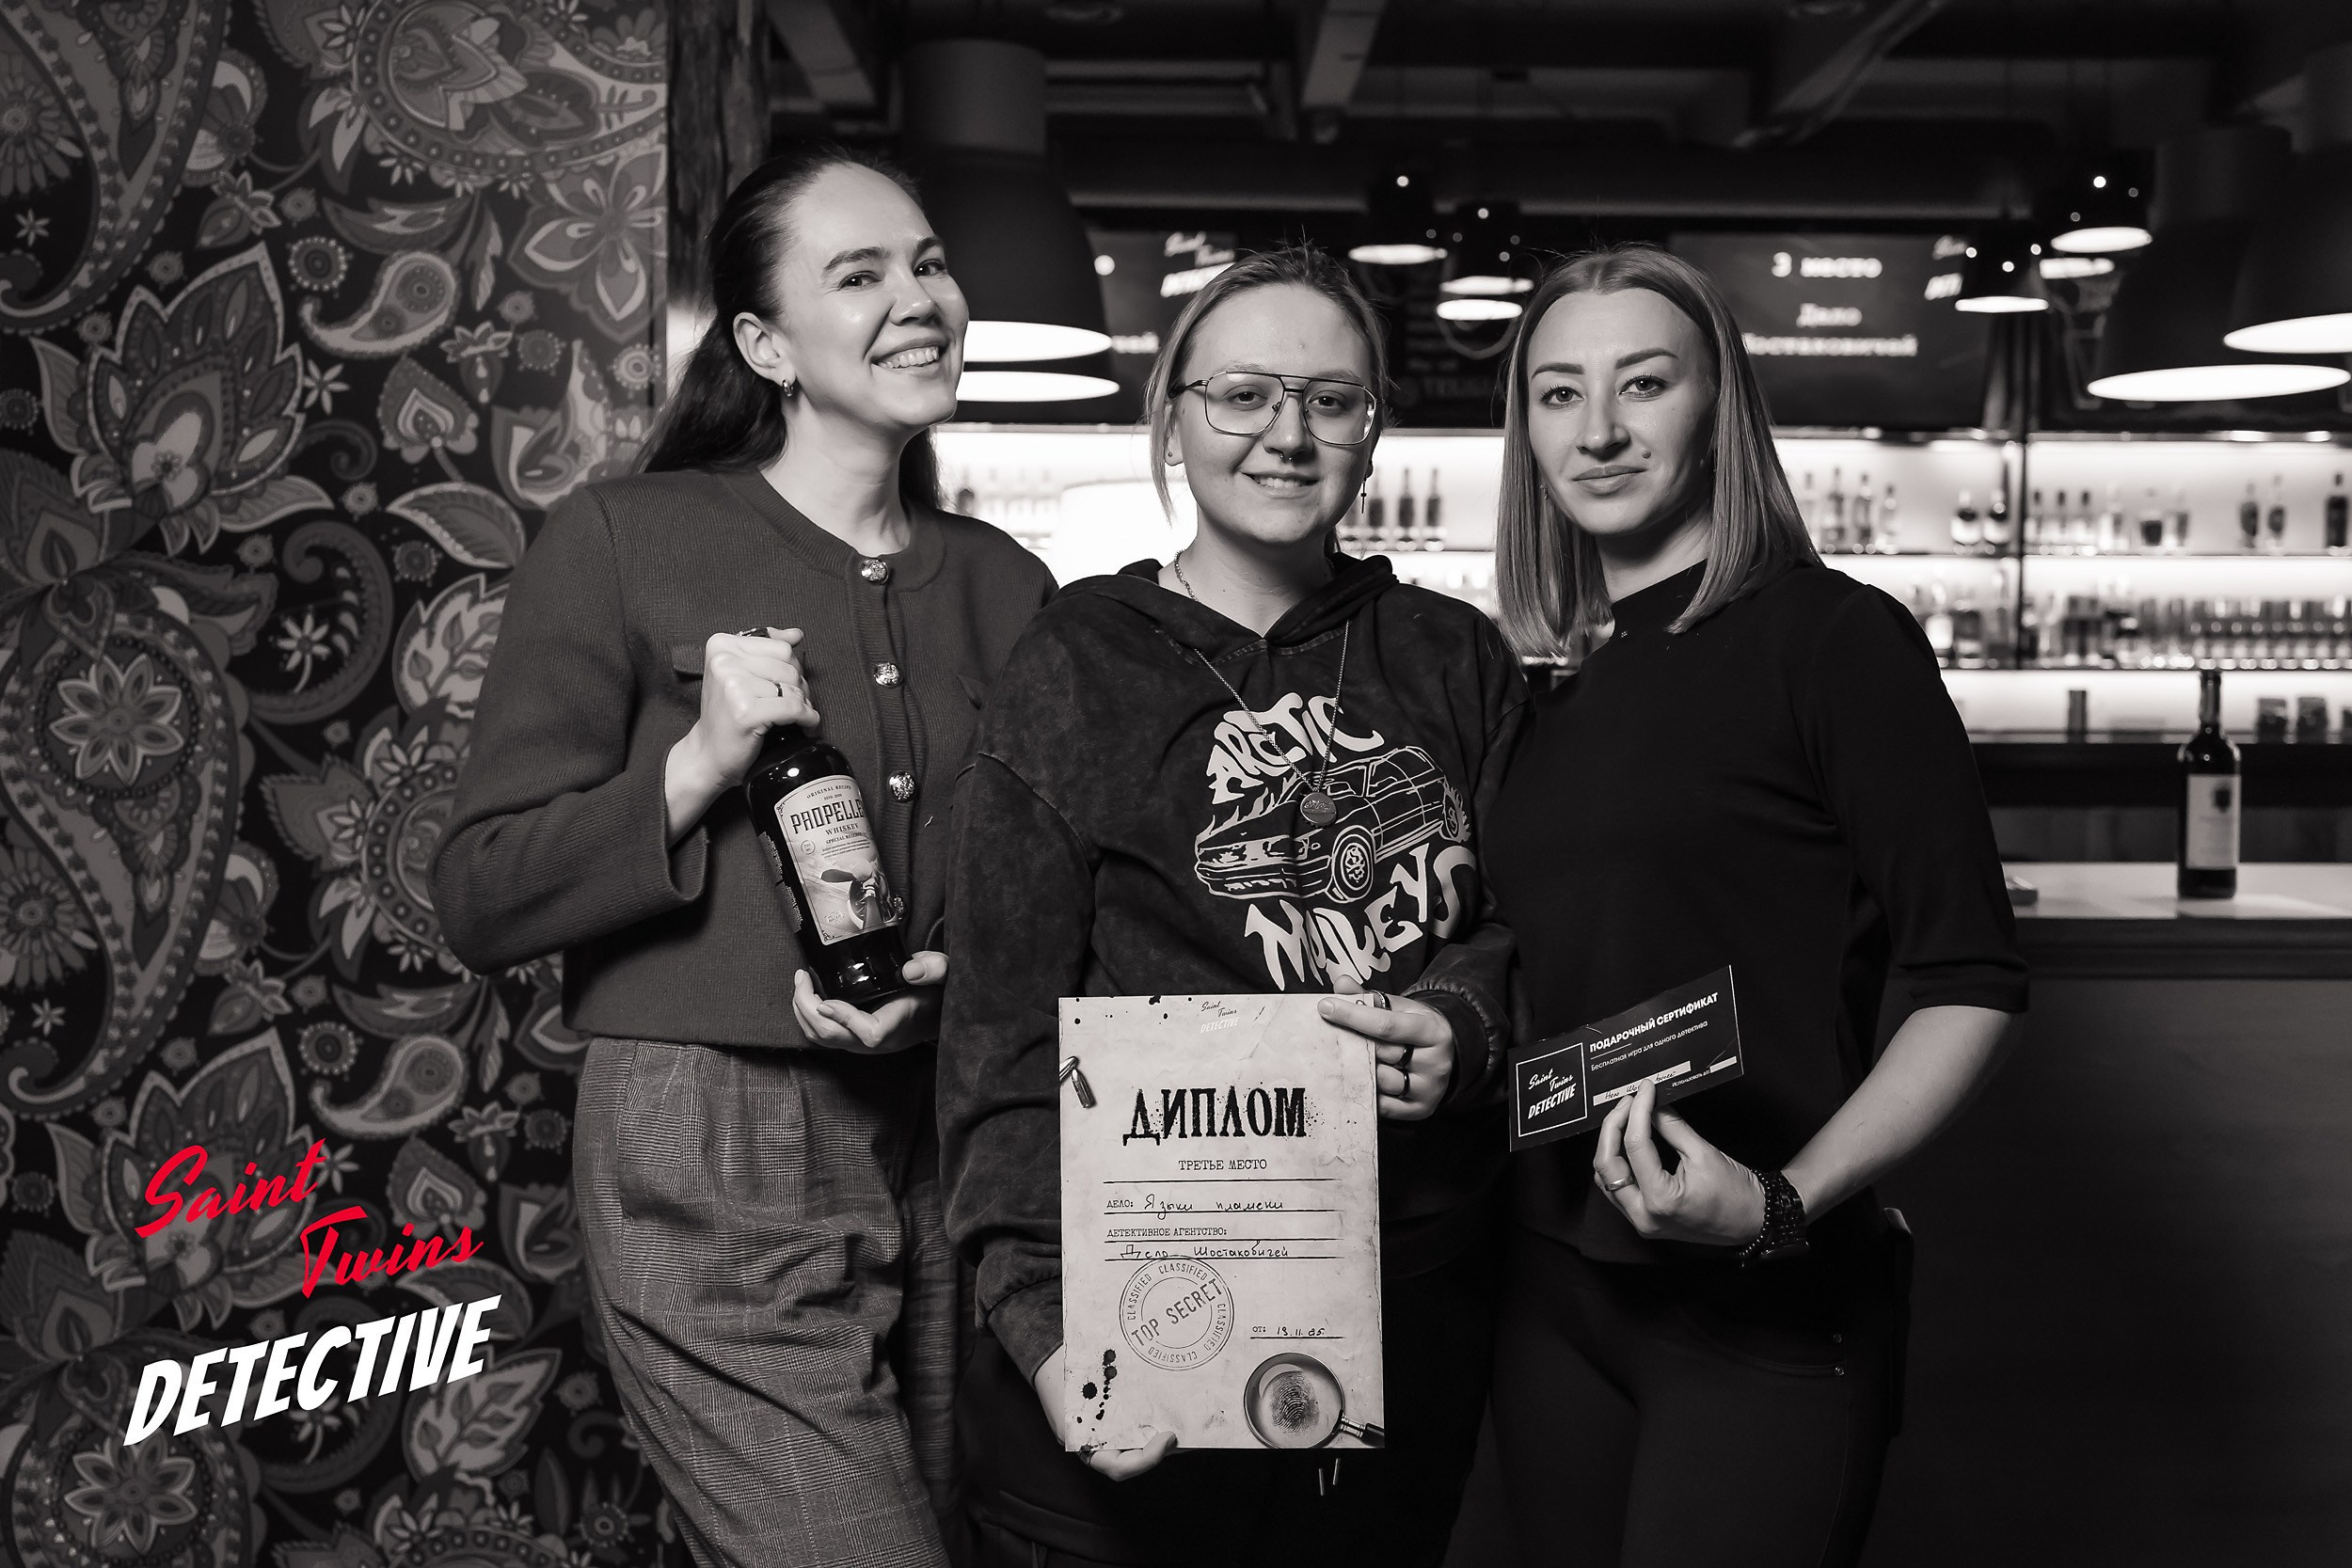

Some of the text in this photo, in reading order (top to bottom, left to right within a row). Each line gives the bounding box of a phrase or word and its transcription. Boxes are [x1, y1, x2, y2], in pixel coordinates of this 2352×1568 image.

[1206, 692, 1385, 805] ARCTIC
[806, 786, 834, 800] ORIGINAL
[790, 799, 865, 834] PROPELLE
[825, 823, 859, 835] WHISKEY
[1201, 1001, 1221, 1012] Saint
[1217, 1006, 1237, 1018] Twins
[1200, 1016, 1240, 1034] DETECTIVE
[1589, 992, 1719, 1053] ПОДАРОЧНЫЙ СЕРТИФИКАТ
[1591, 1021, 1708, 1071] Бесплатная игра для одного детектива
[1528, 1068, 1553, 1090] Saint
[1549, 1074, 1574, 1092] Twins
[1672, 1071, 1703, 1087] Использовать
[1527, 1083, 1577, 1119] DETECTIVE
[1123, 1085, 1308, 1147] ДИПЛОМ
[1178, 1159, 1267, 1171] ТРЕТЬЕ МЕСТО
[1106, 1199, 1134, 1209] ДЕЛО:
[1216, 1199, 1283, 1212] пламени
[1106, 1227, 1227, 1238] ДЕТЕКТИВНОЕ АГЕНТСТВО:
[1158, 1262, 1209, 1282] CLASSIFIED
[1127, 1274, 1152, 1321] CLASSIFIED
[1131, 1278, 1223, 1347] TOP SECRET
[1203, 1303, 1227, 1352] CLASSIFIED
[1148, 1346, 1199, 1364] CLASSIFIED
